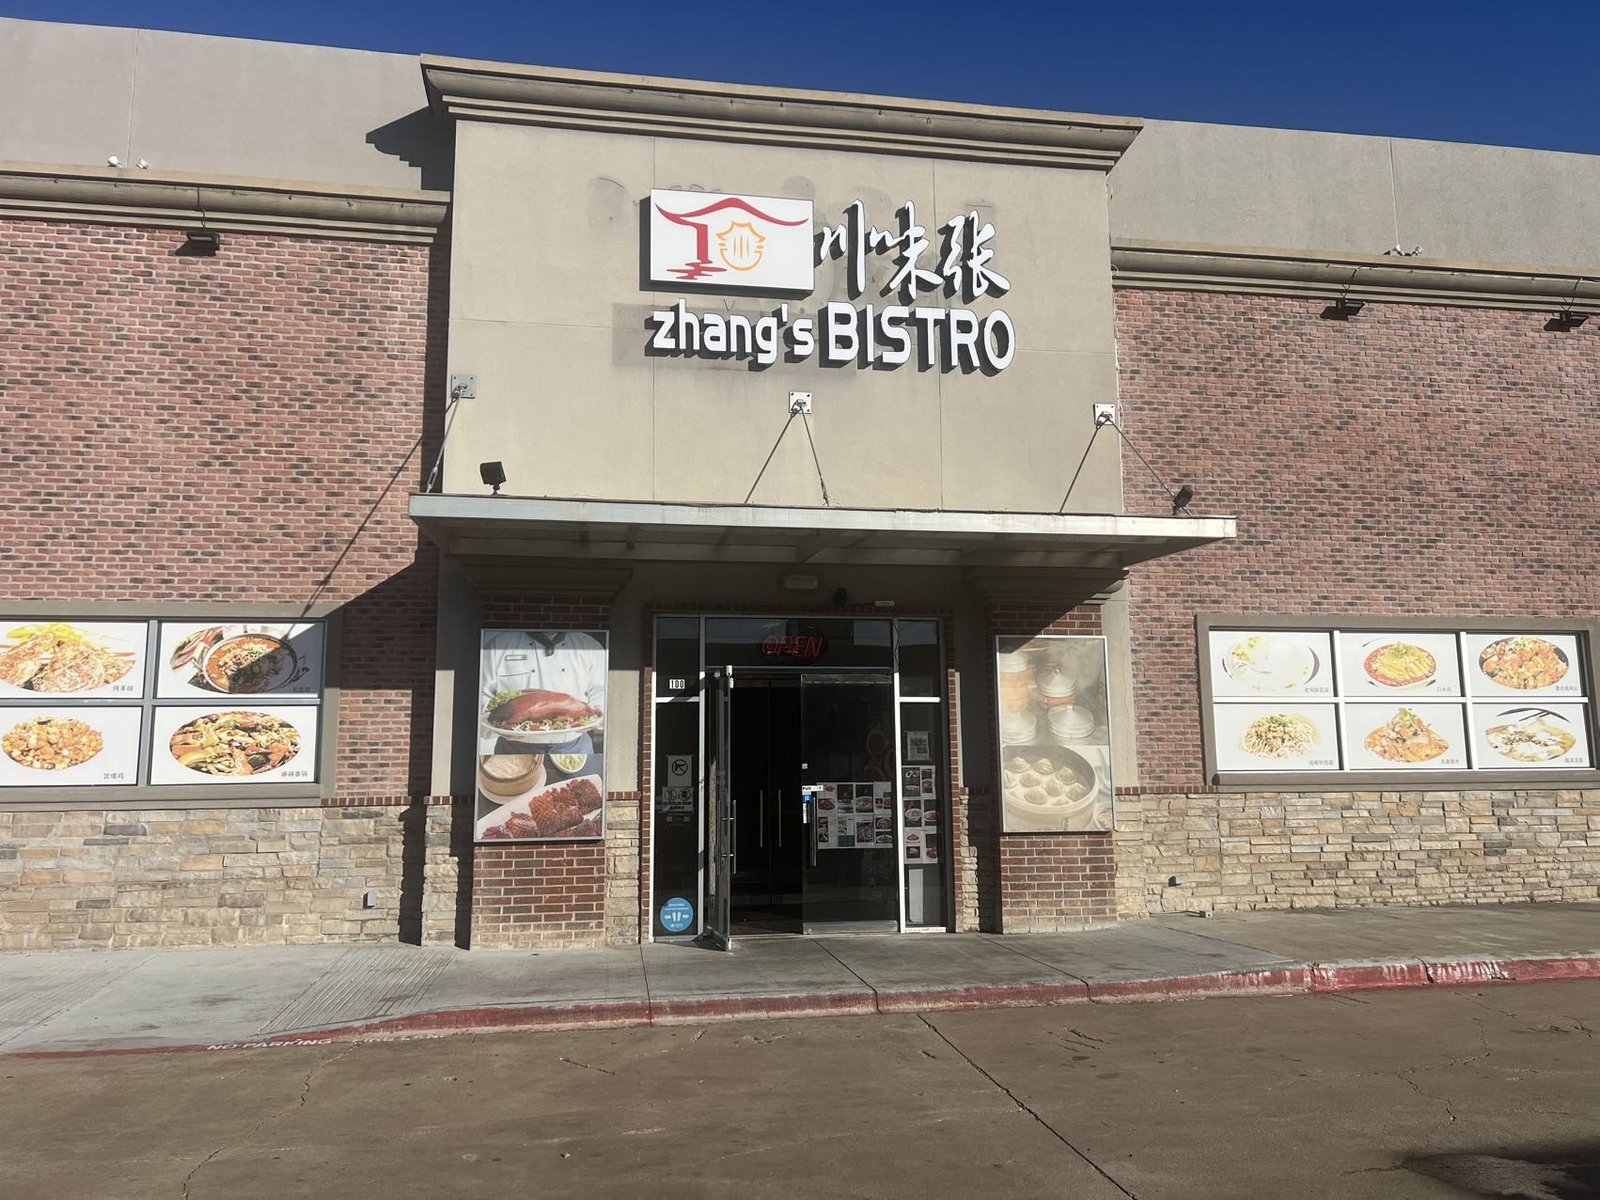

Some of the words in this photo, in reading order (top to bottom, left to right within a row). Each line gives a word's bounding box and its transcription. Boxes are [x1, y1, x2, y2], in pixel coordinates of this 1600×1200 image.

[820, 199, 1012, 300] 川味张
[652, 298, 815, 365] zhang's
[827, 301, 1017, 371] BISTRO
[761, 634, 825, 659] OPEN
[670, 679, 685, 689] 100
[243, 1037, 333, 1049] PARKING
